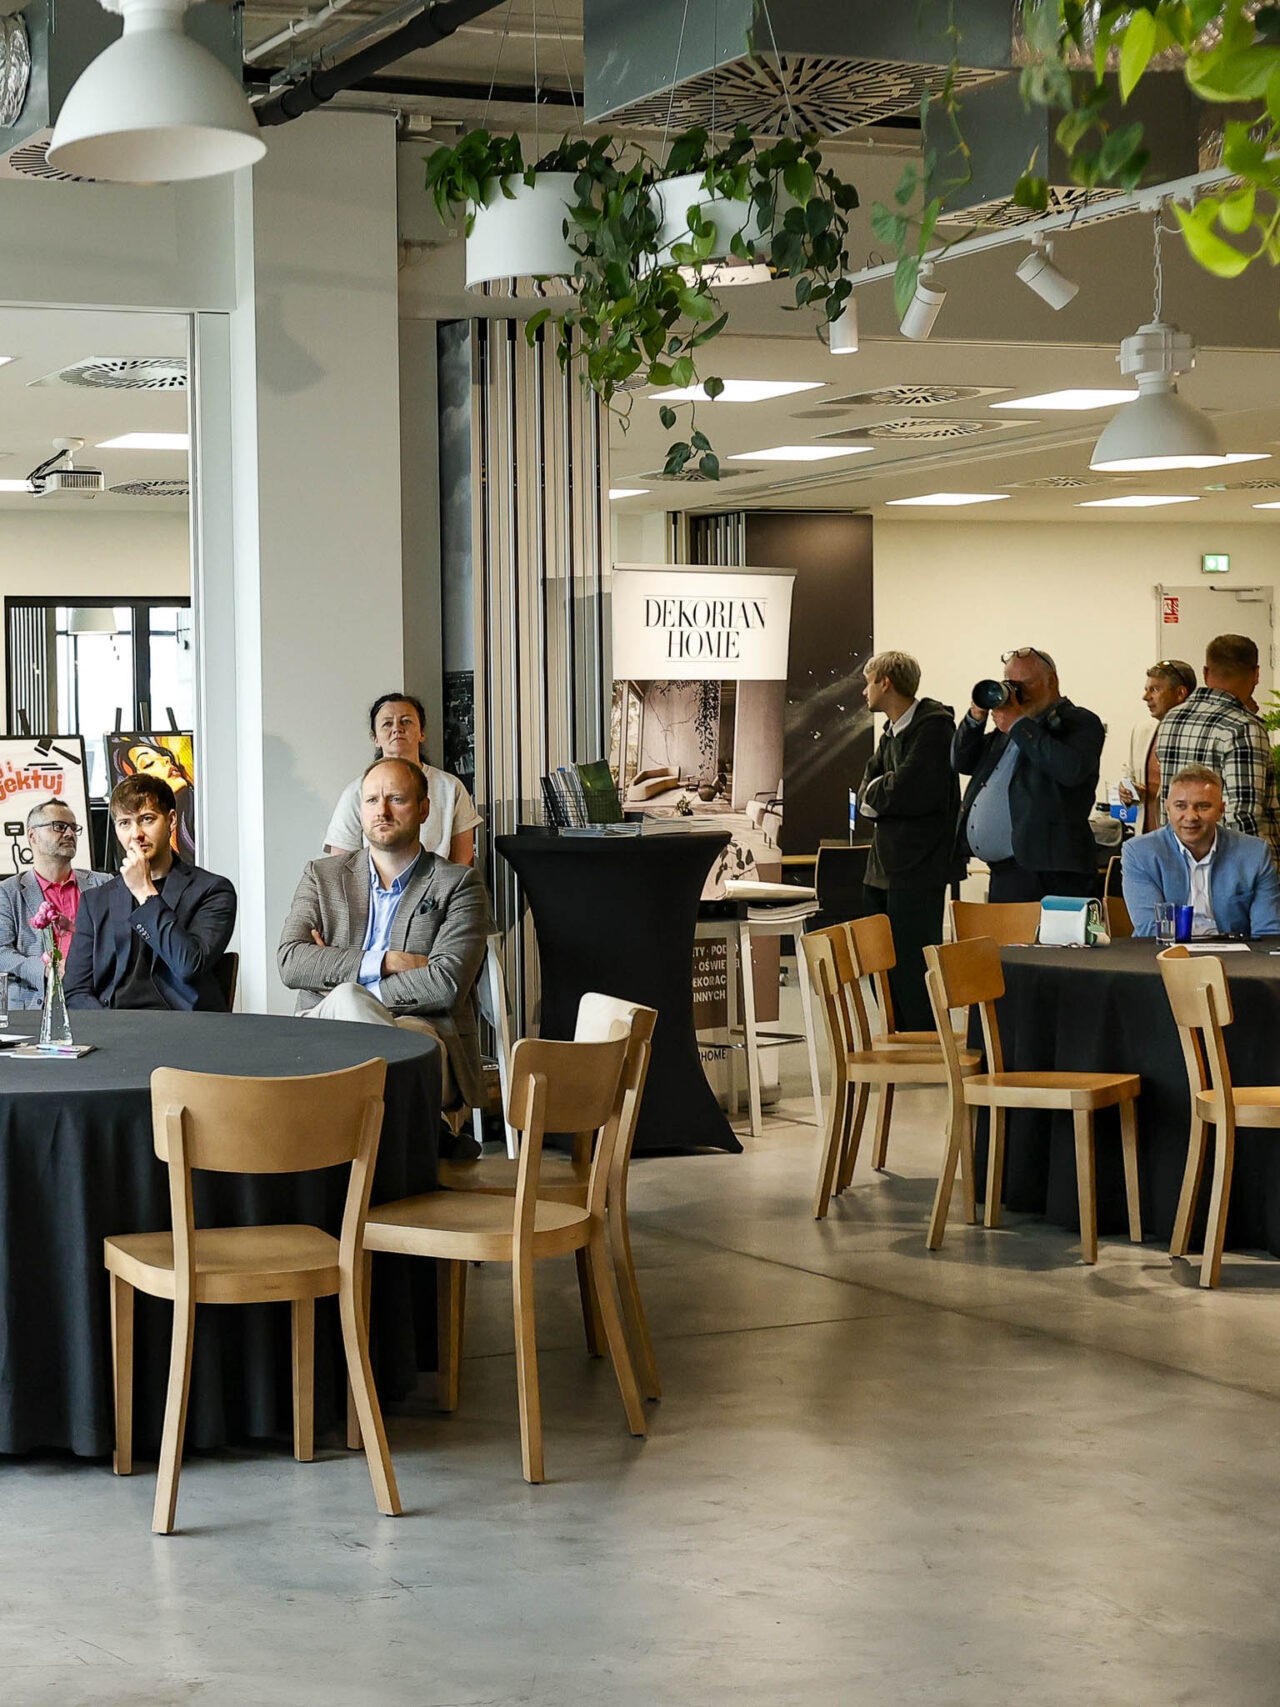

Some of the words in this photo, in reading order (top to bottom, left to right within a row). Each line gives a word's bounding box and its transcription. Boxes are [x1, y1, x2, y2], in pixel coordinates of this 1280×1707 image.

[643, 599, 767, 629] DEKORIAN
[666, 629, 740, 659] HOME
[6, 761, 13, 773] i
[692, 974, 727, 988] EKORAC
[698, 1048, 726, 1062] HOME
